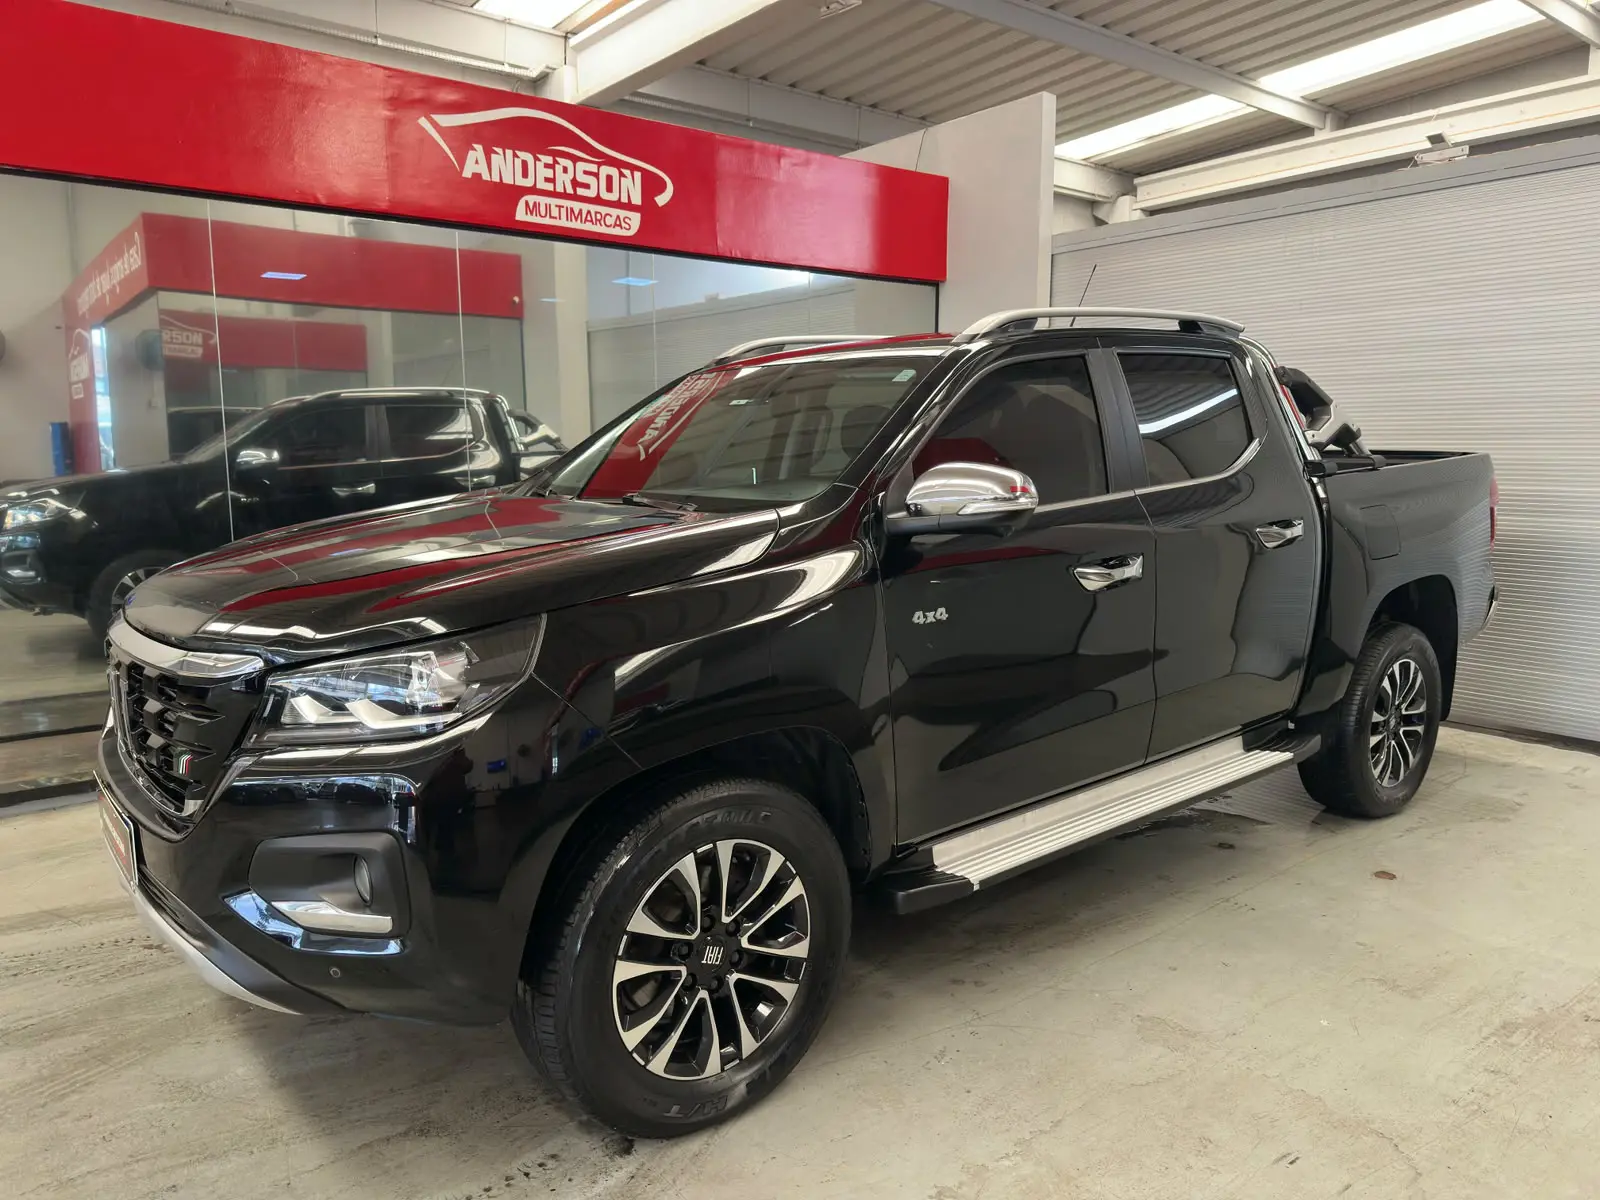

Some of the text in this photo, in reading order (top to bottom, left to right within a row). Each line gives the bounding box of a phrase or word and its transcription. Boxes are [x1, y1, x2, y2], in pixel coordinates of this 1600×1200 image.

[462, 144, 642, 205] ANDERSON
[524, 199, 632, 231] MULTIMARCAS
[912, 607, 949, 624] 4x4
[701, 946, 724, 965] FIAT
